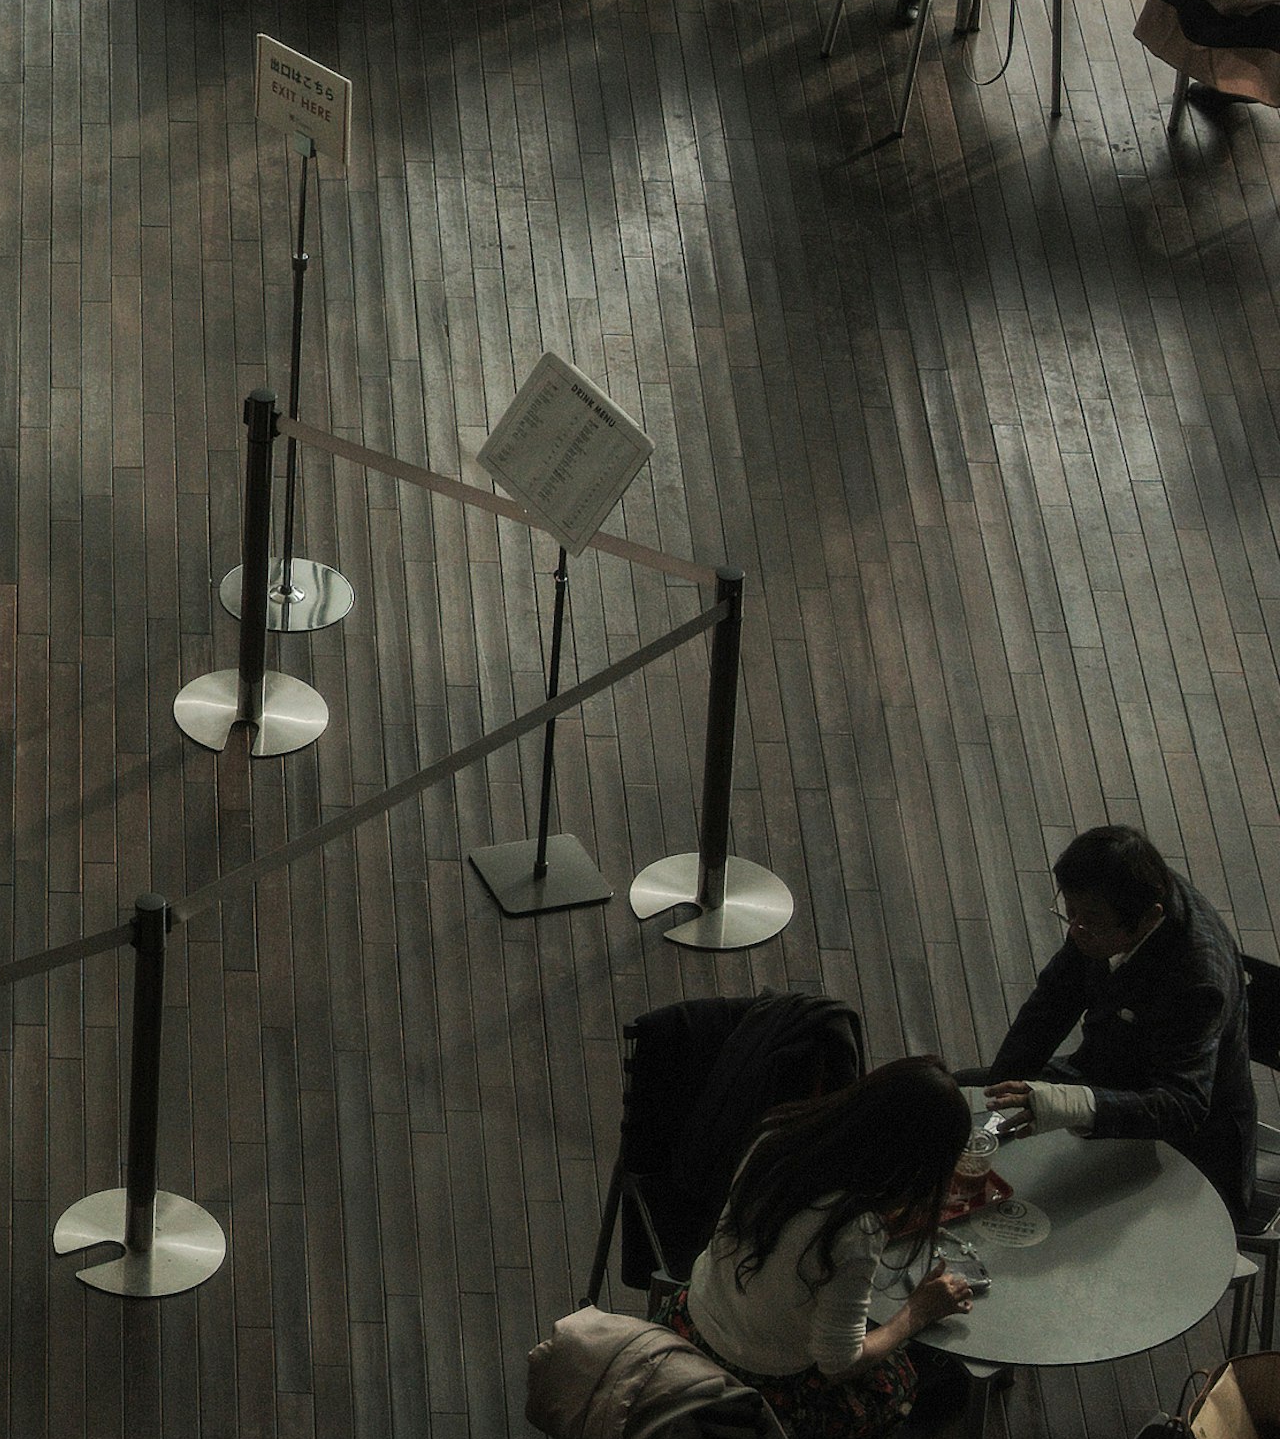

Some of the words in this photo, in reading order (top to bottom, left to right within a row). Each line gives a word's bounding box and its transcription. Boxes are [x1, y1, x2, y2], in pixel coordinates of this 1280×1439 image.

[270, 58, 334, 101] 出口はこちら
[272, 81, 297, 103] EXIT
[301, 96, 332, 122] HERE
[570, 383, 595, 409] DRINK
[594, 402, 617, 428] MENU
